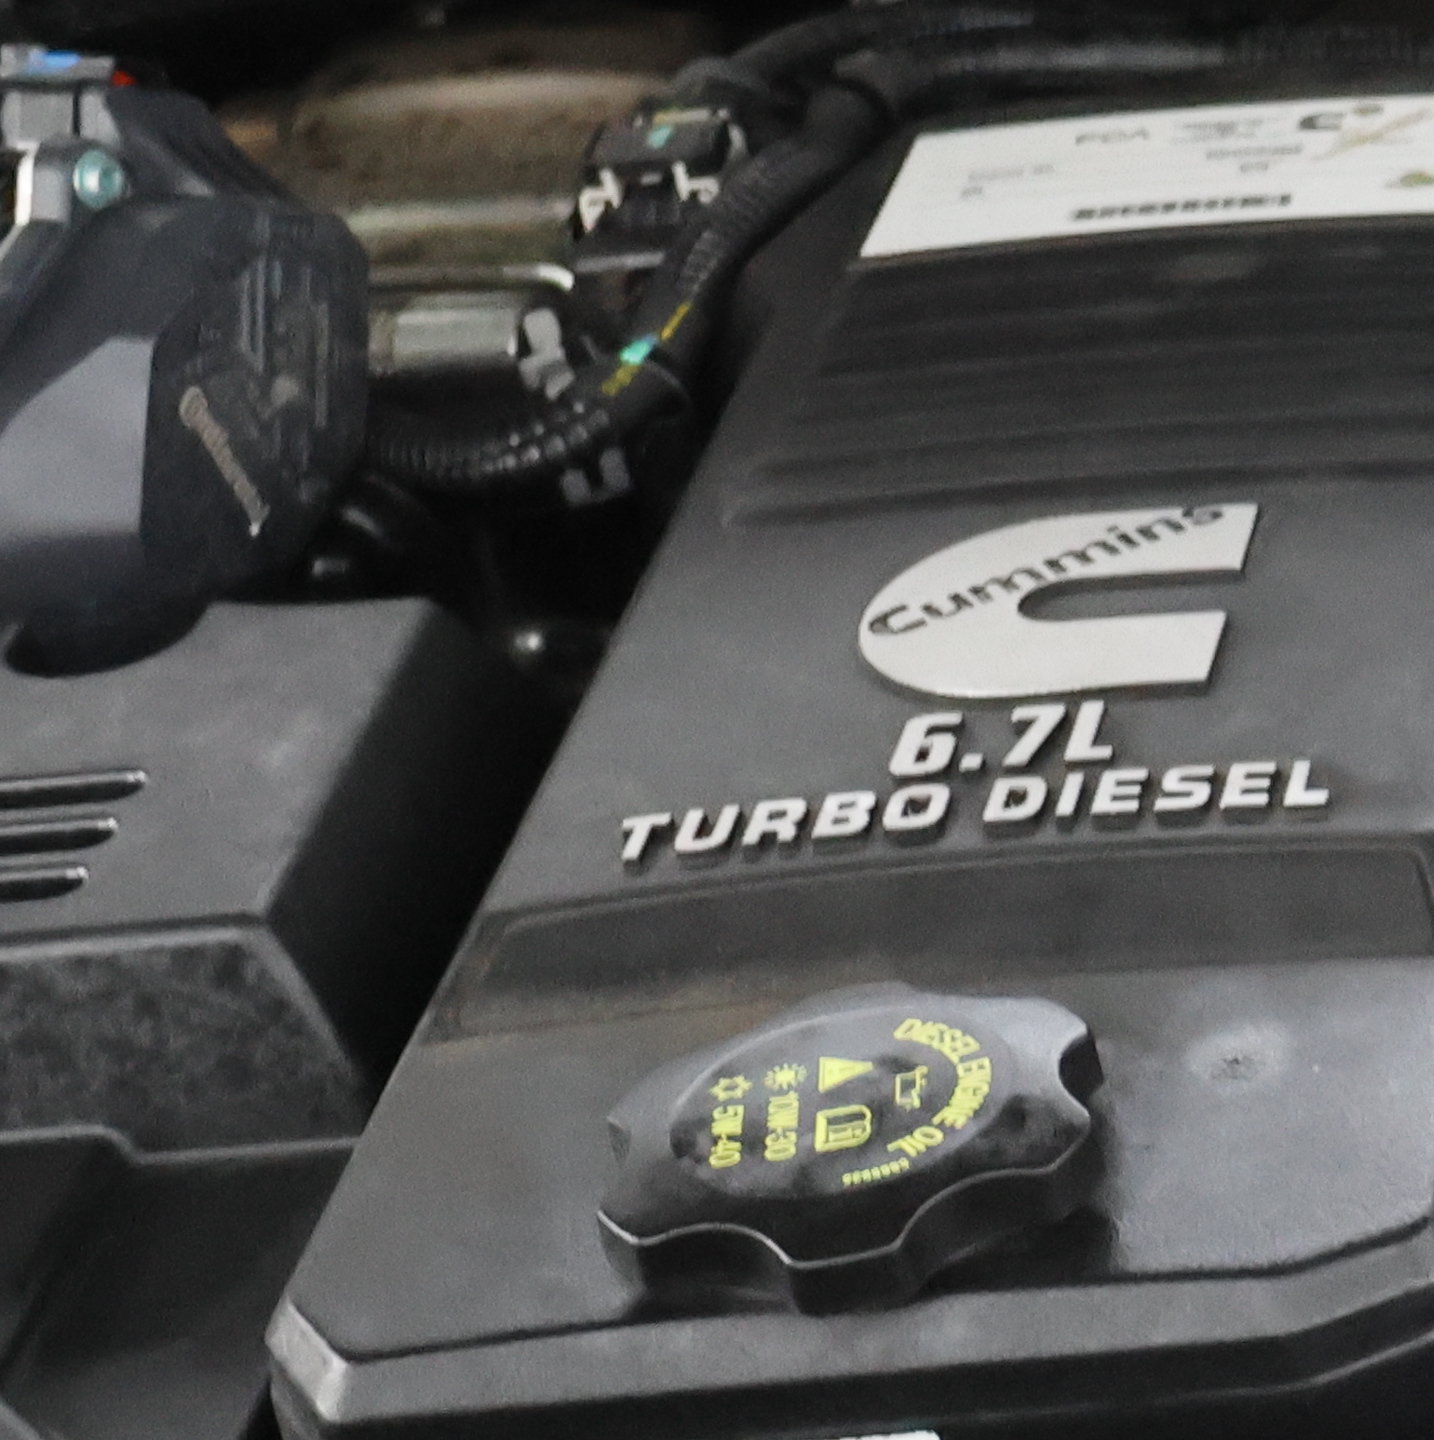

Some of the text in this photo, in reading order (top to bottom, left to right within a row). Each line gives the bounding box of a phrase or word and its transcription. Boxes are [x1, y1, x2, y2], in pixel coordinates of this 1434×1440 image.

[868, 502, 1224, 637] Cummins
[889, 699, 1114, 777] 6.7L
[620, 760, 1331, 860] TURBO DIESEL
[764, 1091, 800, 1161] 10W-30
[932, 1057, 992, 1130] ENGINE
[708, 1104, 745, 1169] 5W-40
[887, 1125, 945, 1157] OIL
